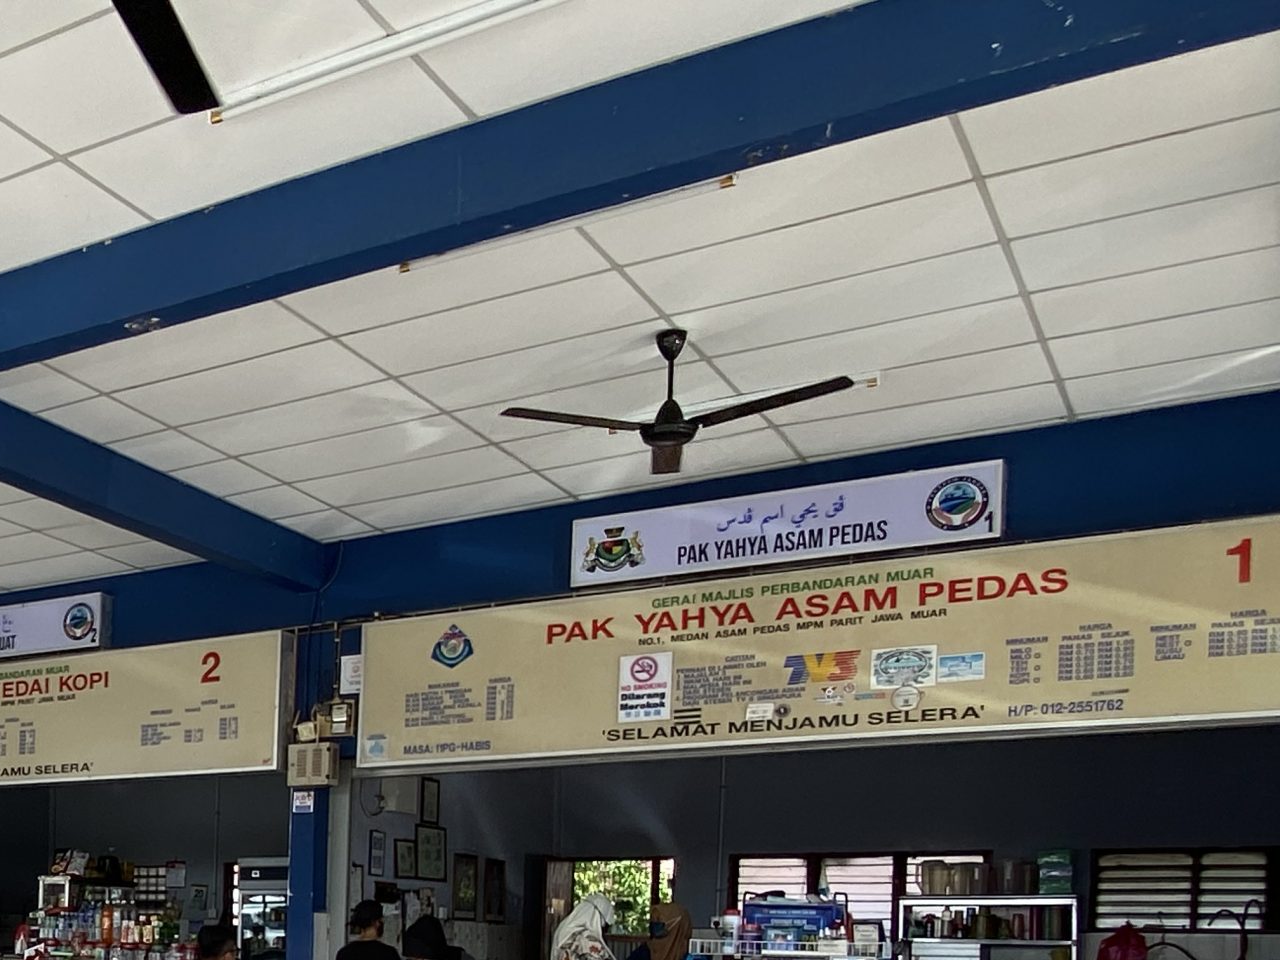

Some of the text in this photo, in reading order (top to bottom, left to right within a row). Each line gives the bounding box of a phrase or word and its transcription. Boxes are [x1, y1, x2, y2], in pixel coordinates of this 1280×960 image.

[984, 511, 994, 533] 1
[677, 519, 888, 566] PAK YAHYA ASAM PEDAS
[1226, 538, 1251, 583] 1
[651, 567, 935, 609] GERAI MAJLIS PERBANDARAN MUAR
[546, 568, 1069, 645] PAK YAHYA ASAM PEDAS
[91, 628, 97, 643] 2
[670, 631, 709, 643] MEDAN
[714, 627, 748, 639] ASAM
[752, 623, 790, 636] PEDAS
[796, 620, 824, 631] MPM
[830, 616, 864, 628] PARIT
[870, 612, 903, 624] JAWA
[910, 608, 948, 619] MUAR
[59, 671, 109, 693] KOPI
[200, 651, 221, 683] 2
[728, 713, 859, 734] MENJAMU
[867, 705, 985, 725] SELERA'
[1041, 699, 1124, 715] 012-2551762
